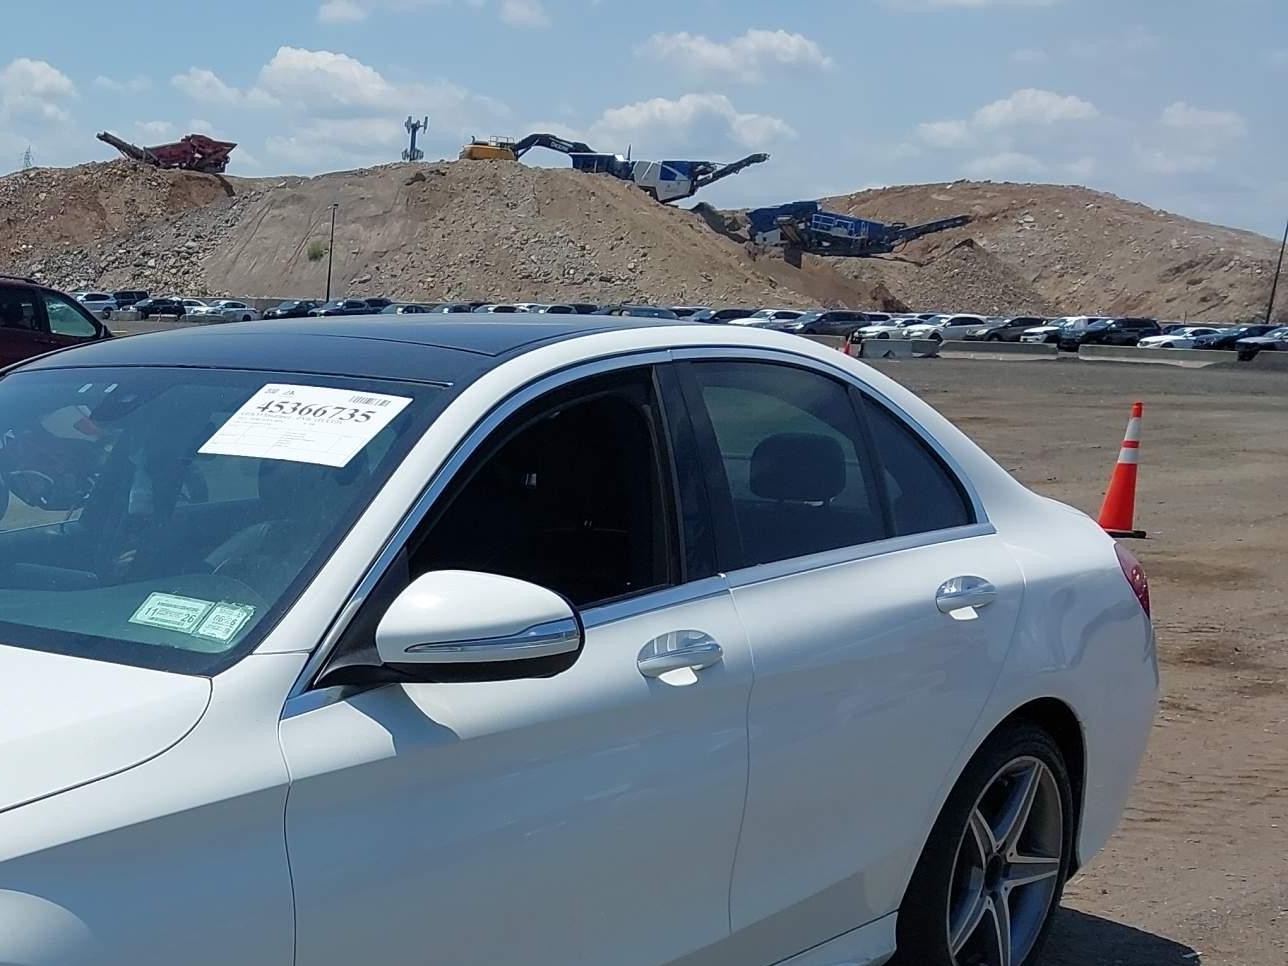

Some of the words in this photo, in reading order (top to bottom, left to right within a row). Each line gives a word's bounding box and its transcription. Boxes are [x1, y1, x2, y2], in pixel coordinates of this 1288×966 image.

[256, 400, 377, 424] 45366735
[144, 607, 159, 617] 11
[180, 613, 196, 623] 26
